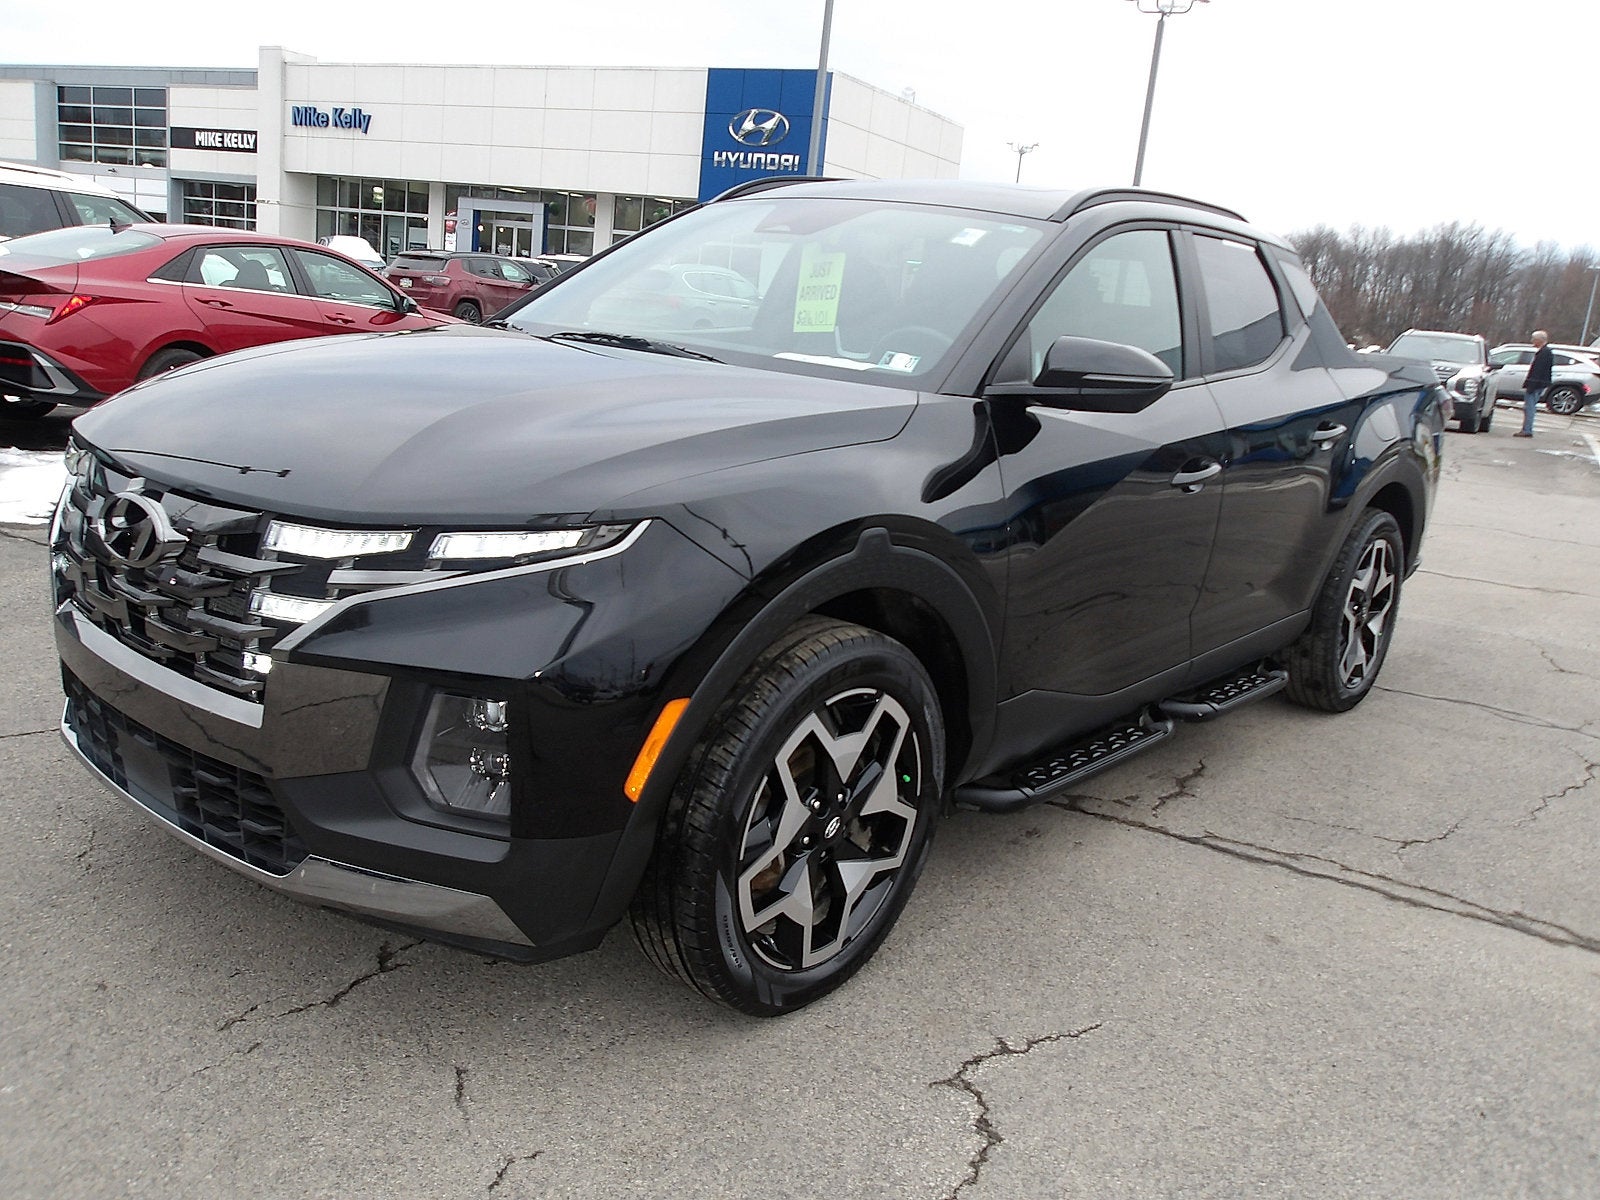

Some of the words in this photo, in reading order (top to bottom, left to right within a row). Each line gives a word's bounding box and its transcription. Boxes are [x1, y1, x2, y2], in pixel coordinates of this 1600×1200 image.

[291, 105, 329, 128] Mike
[331, 107, 372, 135] Kelly
[195, 131, 223, 147] MIKE
[224, 133, 256, 149] KELLY
[713, 150, 800, 172] HYUNDAI
[809, 261, 833, 278] JUST
[799, 284, 837, 301] ARRIVED
